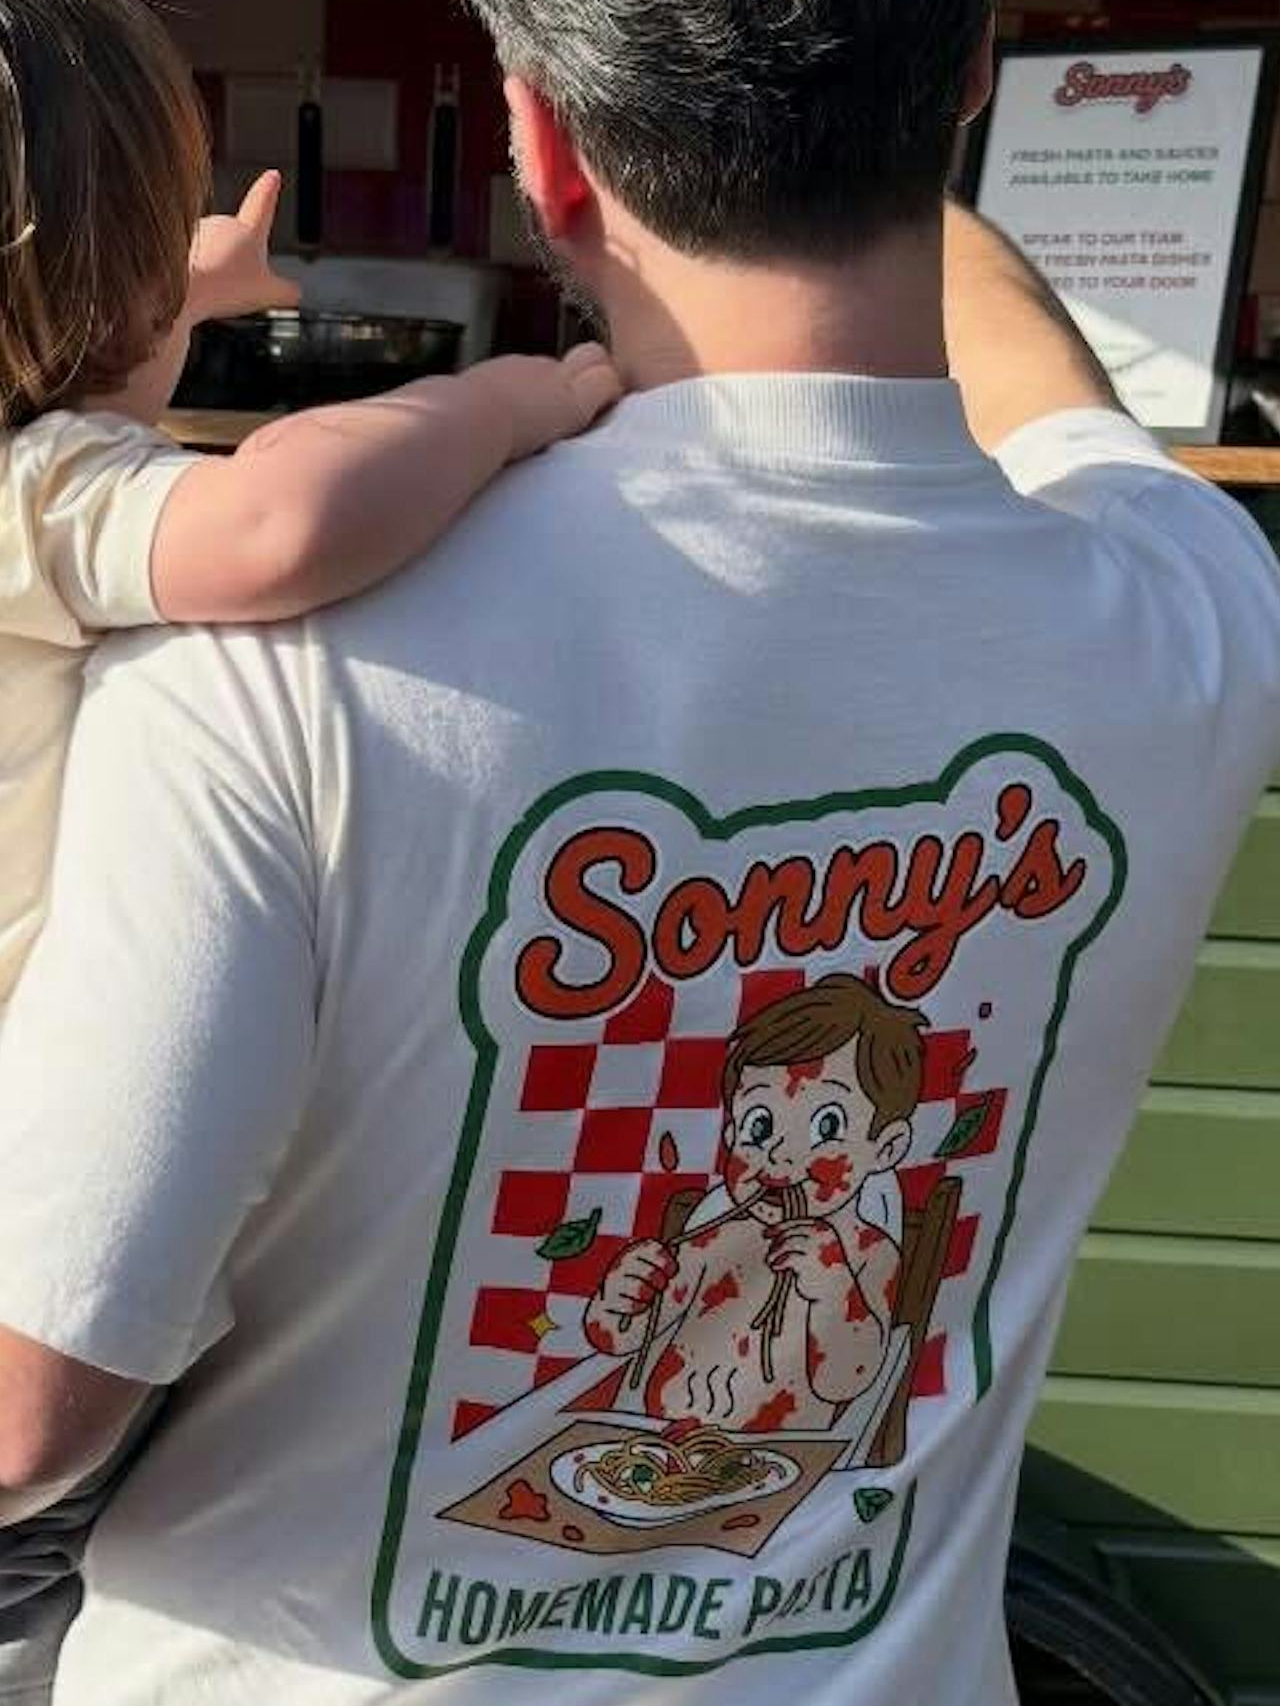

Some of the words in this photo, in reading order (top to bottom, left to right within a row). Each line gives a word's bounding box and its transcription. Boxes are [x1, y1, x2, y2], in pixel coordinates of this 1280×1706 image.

[1053, 61, 1192, 114] Sonny's
[1010, 148, 1062, 162] FRESH
[1066, 148, 1113, 161] PASTA
[1118, 148, 1152, 161] AND
[1155, 147, 1219, 160] SAUCES
[1009, 171, 1094, 185] AVAILABLE
[1097, 171, 1119, 184] TO
[1122, 169, 1163, 184] TAKE
[1165, 168, 1217, 183] HOME
[1023, 233, 1073, 245] SPEAK
[1076, 233, 1098, 245] TO
[1101, 233, 1136, 245] OUR
[1140, 232, 1184, 245] TEAM
[1044, 254, 1097, 267] FRESH
[1099, 254, 1148, 266] PASTA
[1151, 253, 1213, 267] DISHES
[1077, 277, 1100, 289] TO
[1103, 277, 1146, 290] YOUR
[1149, 277, 1199, 290] DOOR
[516, 784, 1086, 1020] Sonny's
[415, 1570, 734, 1645] HOMEMADE
